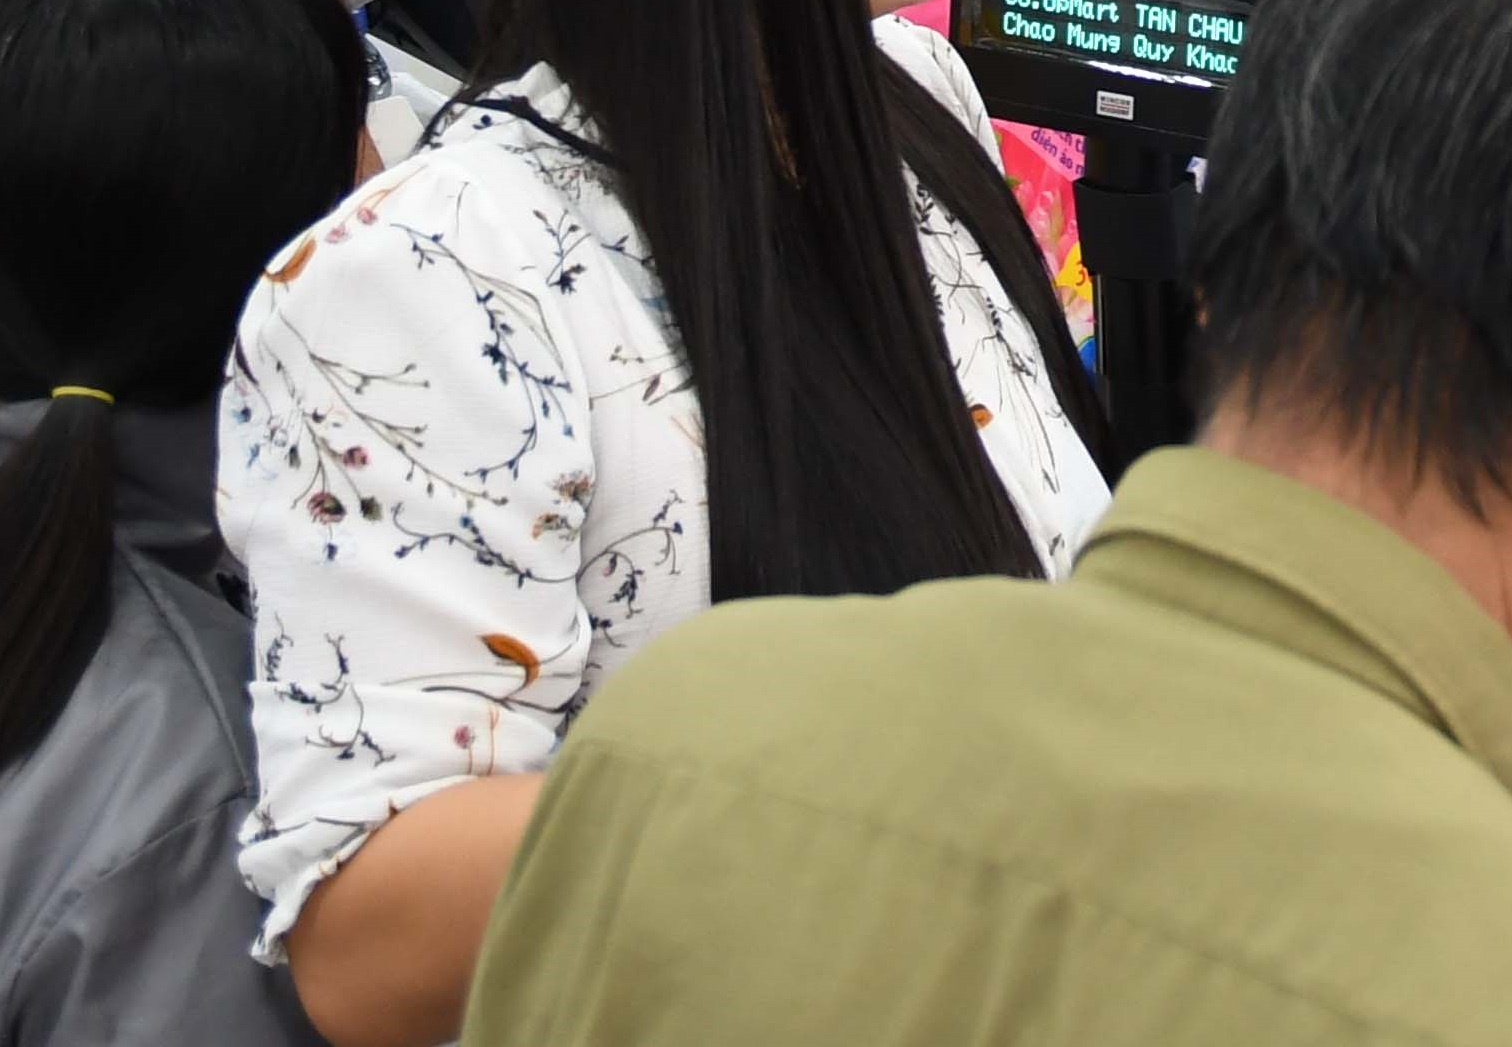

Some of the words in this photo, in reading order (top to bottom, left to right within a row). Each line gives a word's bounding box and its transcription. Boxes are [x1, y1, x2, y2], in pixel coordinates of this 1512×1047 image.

[1003, 11, 1056, 42] Chao
[1067, 22, 1121, 54] Mung
[1133, 34, 1175, 63] Quy
[1135, 3, 1176, 34] TAN
[1188, 13, 1243, 45] CHAU
